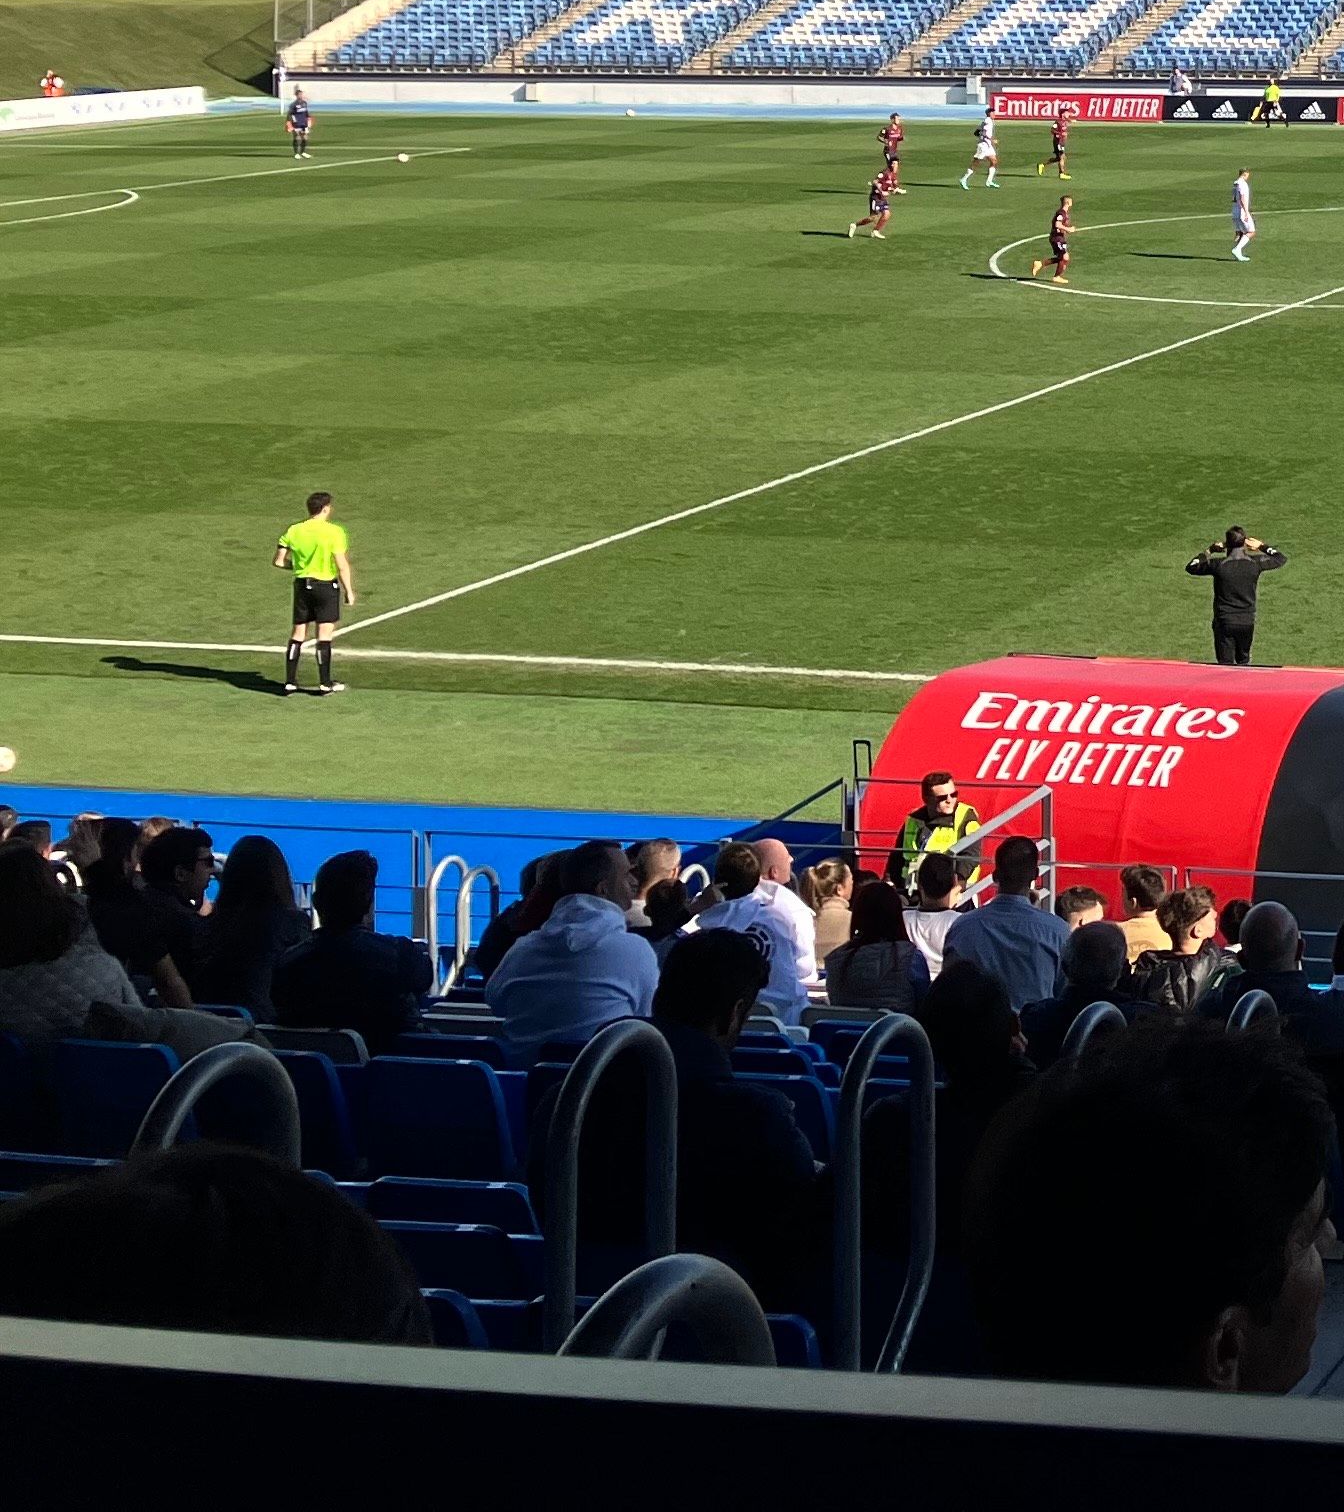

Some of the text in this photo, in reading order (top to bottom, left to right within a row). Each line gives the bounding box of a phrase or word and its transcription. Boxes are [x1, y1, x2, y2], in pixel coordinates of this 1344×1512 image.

[1087, 98, 1109, 118] FLY
[1111, 98, 1161, 119] BETTER
[960, 691, 1246, 740] Emirates
[976, 738, 1184, 788] FLY BETTER
